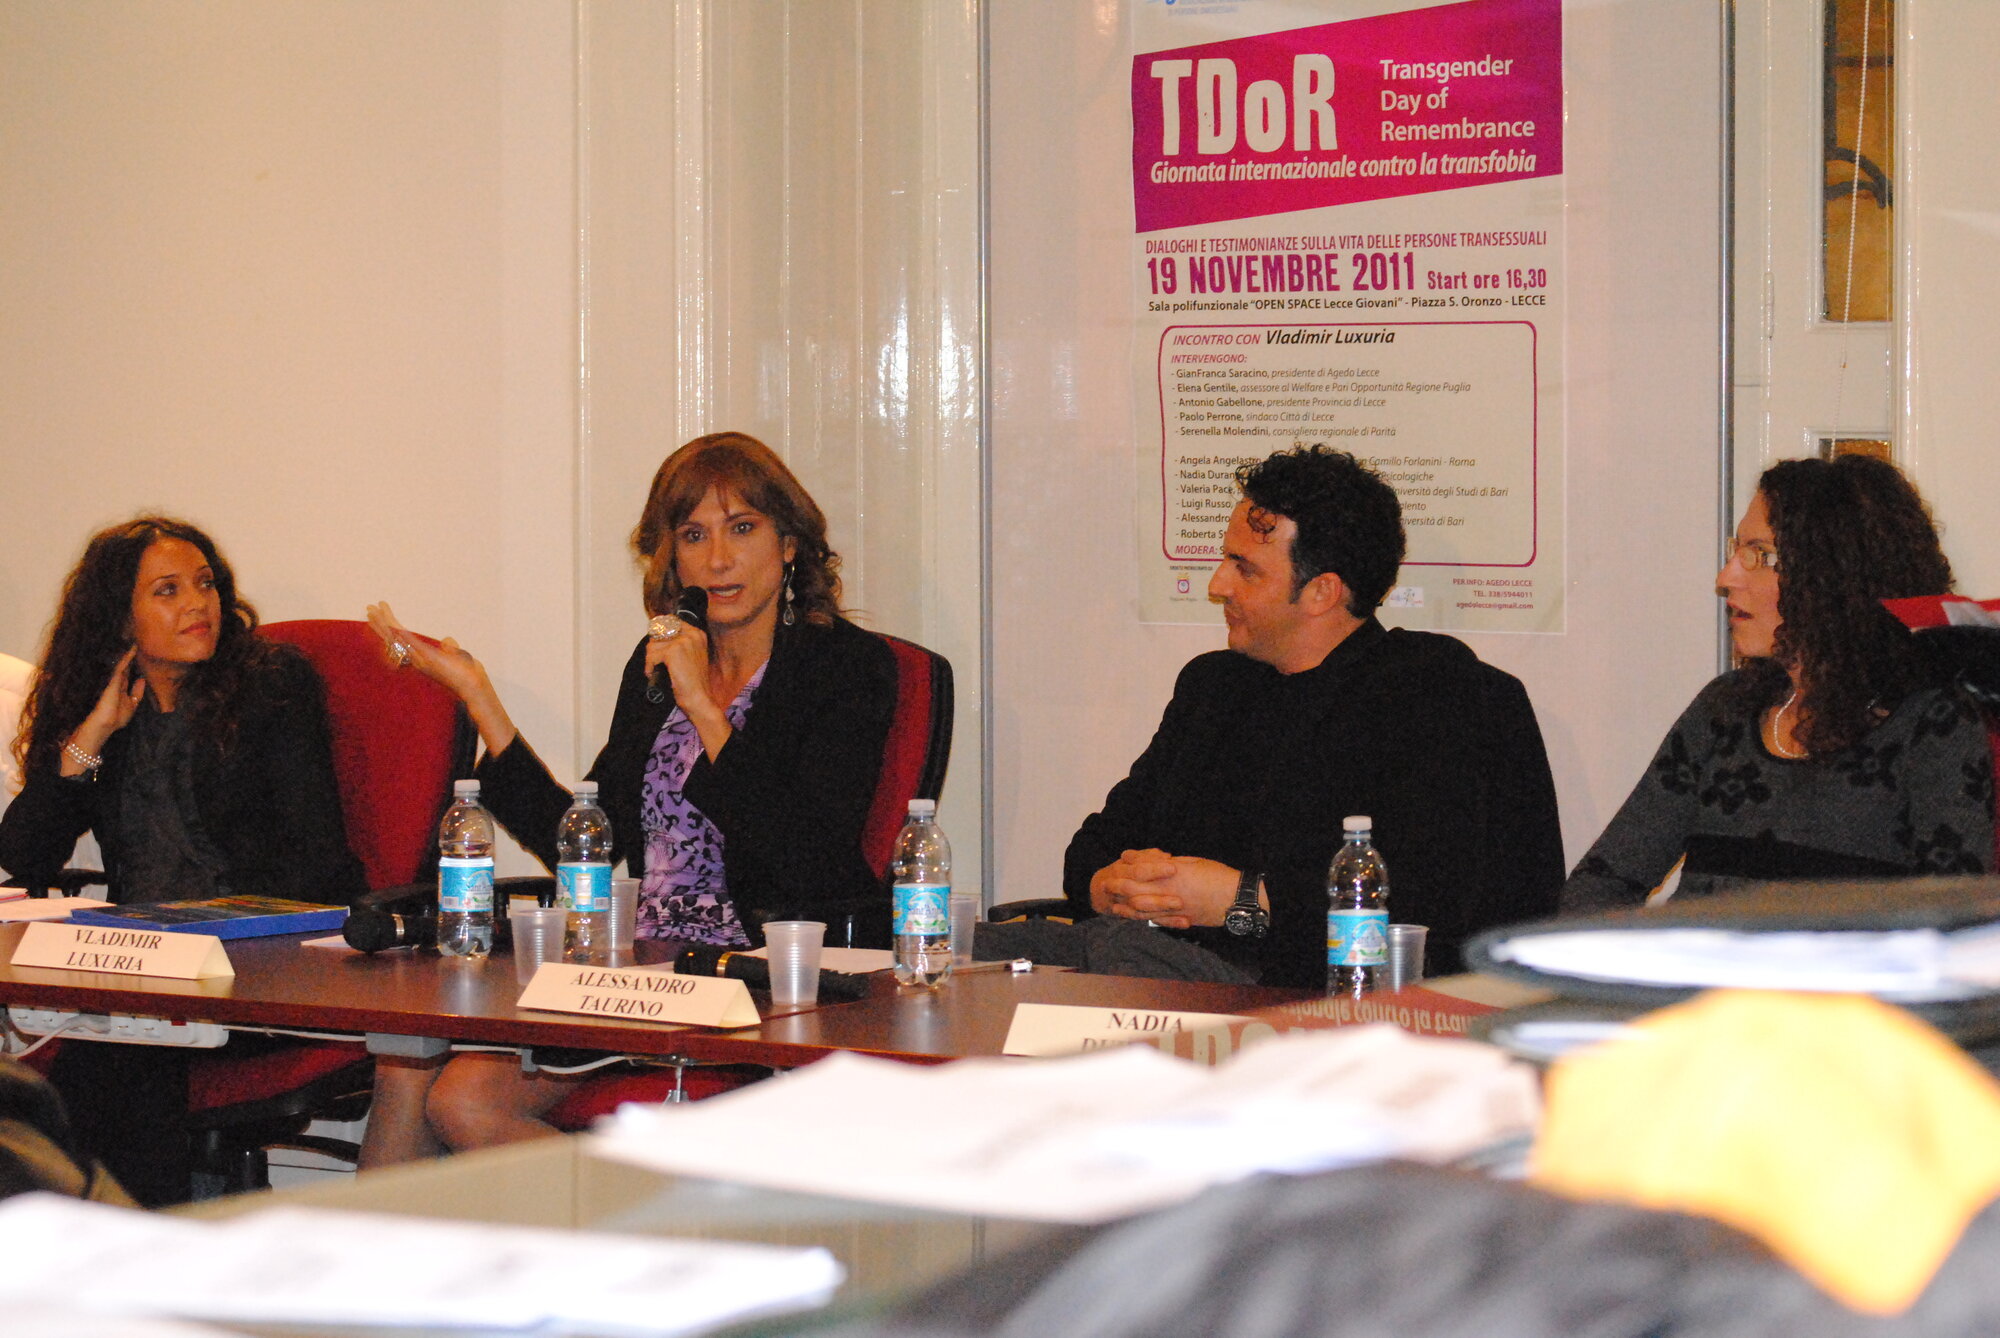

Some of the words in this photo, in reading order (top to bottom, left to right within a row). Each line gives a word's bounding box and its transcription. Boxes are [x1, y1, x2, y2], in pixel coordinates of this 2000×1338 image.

[1379, 54, 1514, 84] Transgender
[1150, 53, 1338, 156] TDoR
[1381, 89, 1422, 116] Day
[1426, 86, 1449, 109] of
[1381, 117, 1536, 142] Remembrance
[1151, 160, 1226, 184] Giornata
[1229, 154, 1357, 182] internazionale
[1359, 154, 1416, 178] contro
[1419, 151, 1438, 175] la
[1441, 148, 1537, 175] transfobia
[1145, 239, 1198, 254] DIALOGHI
[1201, 239, 1207, 253] E
[1209, 236, 1299, 253] TESTIMONIANZE
[1301, 235, 1336, 250] SULLA
[1338, 234, 1364, 249] VITA
[1367, 234, 1401, 249] DELLE
[1404, 233, 1457, 248] PERSONE
[1459, 231, 1547, 247] TRANSESSUALI
[1147, 256, 1178, 295] 19
[1189, 253, 1341, 294] NOVEMBRE
[1352, 251, 1415, 291] 2011
[1427, 270, 1468, 290] Start
[1473, 274, 1500, 290] ore
[1506, 268, 1547, 291] 16,30
[1148, 300, 1170, 312] Sala
[1172, 299, 1249, 314] polifunzionale
[1287, 298, 1321, 310] SPACE
[1324, 298, 1354, 309] Lecce
[1411, 296, 1446, 308] Piazza
[1449, 296, 1459, 307] S.
[1461, 296, 1503, 307] Oronzo
[1511, 295, 1546, 306] LECCE
[1173, 334, 1234, 346] INCONTRO
[1235, 334, 1261, 345] CON
[1266, 329, 1333, 345] Vladimir
[1335, 328, 1395, 344] Luxuria
[1171, 354, 1248, 364] INTERVENGONO:
[1176, 368, 1227, 378] GianFranca
[1228, 368, 1270, 379] Saracino,
[1271, 368, 1316, 379] presidente
[1317, 368, 1326, 378] di
[1327, 368, 1355, 379] Agedo
[1356, 368, 1380, 378] Lecce
[1177, 383, 1202, 393] Elena
[1203, 383, 1239, 394] Gentile,
[1240, 384, 1280, 393] assessore
[1281, 383, 1290, 393] al
[1291, 383, 1323, 393] Welfare
[1331, 382, 1349, 393] Pari
[1405, 382, 1441, 394] Regione
[1442, 382, 1472, 394] Puglia
[1178, 398, 1215, 407] Antonio
[1216, 398, 1265, 408] Gabellone,
[1266, 398, 1311, 409] presidente
[1311, 397, 1351, 407] Provincia
[1353, 397, 1362, 407] di
[1363, 397, 1387, 407] Lecce
[1179, 412, 1205, 422] Paolo
[1206, 412, 1244, 423] Perrone,
[1246, 412, 1279, 422] sindaco
[1301, 412, 1311, 422] di
[1311, 412, 1335, 422] Lecce
[1180, 426, 1222, 436] Serenella
[1223, 427, 1271, 437] Molendini,
[1272, 427, 1318, 438] consigliera
[1319, 427, 1359, 438] regionale
[1360, 426, 1369, 436] di
[1179, 455, 1211, 467] Angela
[1368, 456, 1402, 467] Camillo
[1403, 456, 1442, 467] Forlanini
[1449, 456, 1476, 467] Roma
[1180, 470, 1206, 479] Nadia
[1207, 470, 1236, 479] Duran
[1180, 484, 1211, 494] Valeria
[1432, 486, 1454, 498] degli
[1455, 486, 1478, 497] Studi
[1479, 486, 1489, 497] di
[1490, 487, 1509, 497] Bari
[1181, 499, 1203, 510] Luigi
[1181, 513, 1231, 523] Alessandro
[1436, 516, 1446, 526] di
[1447, 516, 1465, 526] Bari
[1180, 529, 1216, 539] Roberta
[1175, 545, 1218, 555] MODERA:
[1485, 579, 1511, 587] AGEDO
[1511, 579, 1533, 587] LECCE
[74, 929, 163, 949] VLADIMIR
[66, 951, 144, 971] LUXURIA
[570, 971, 697, 996] ALESSANDRO
[578, 995, 664, 1017] TAURINO
[1107, 1012, 1184, 1032] NADIA
